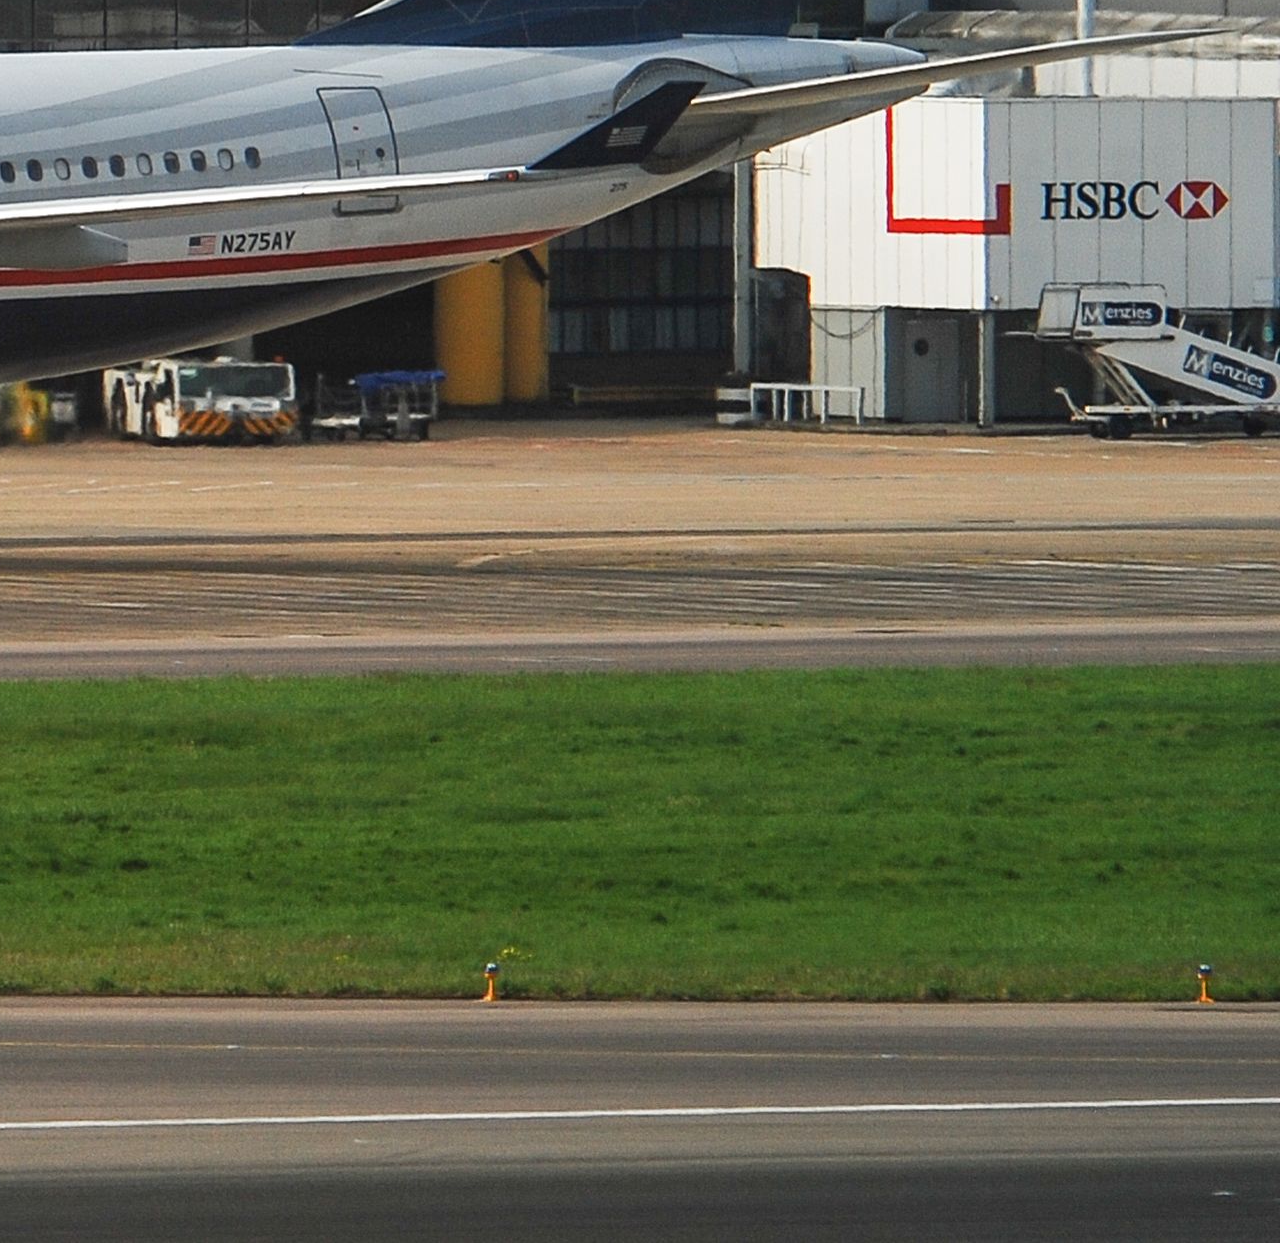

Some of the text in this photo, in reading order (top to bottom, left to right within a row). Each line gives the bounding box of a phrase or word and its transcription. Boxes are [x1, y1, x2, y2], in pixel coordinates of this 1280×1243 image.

[1040, 180, 1160, 220] HSBC
[221, 230, 296, 254] N275AY
[1082, 302, 1154, 326] Menzies
[1185, 348, 1266, 390] Menzies
